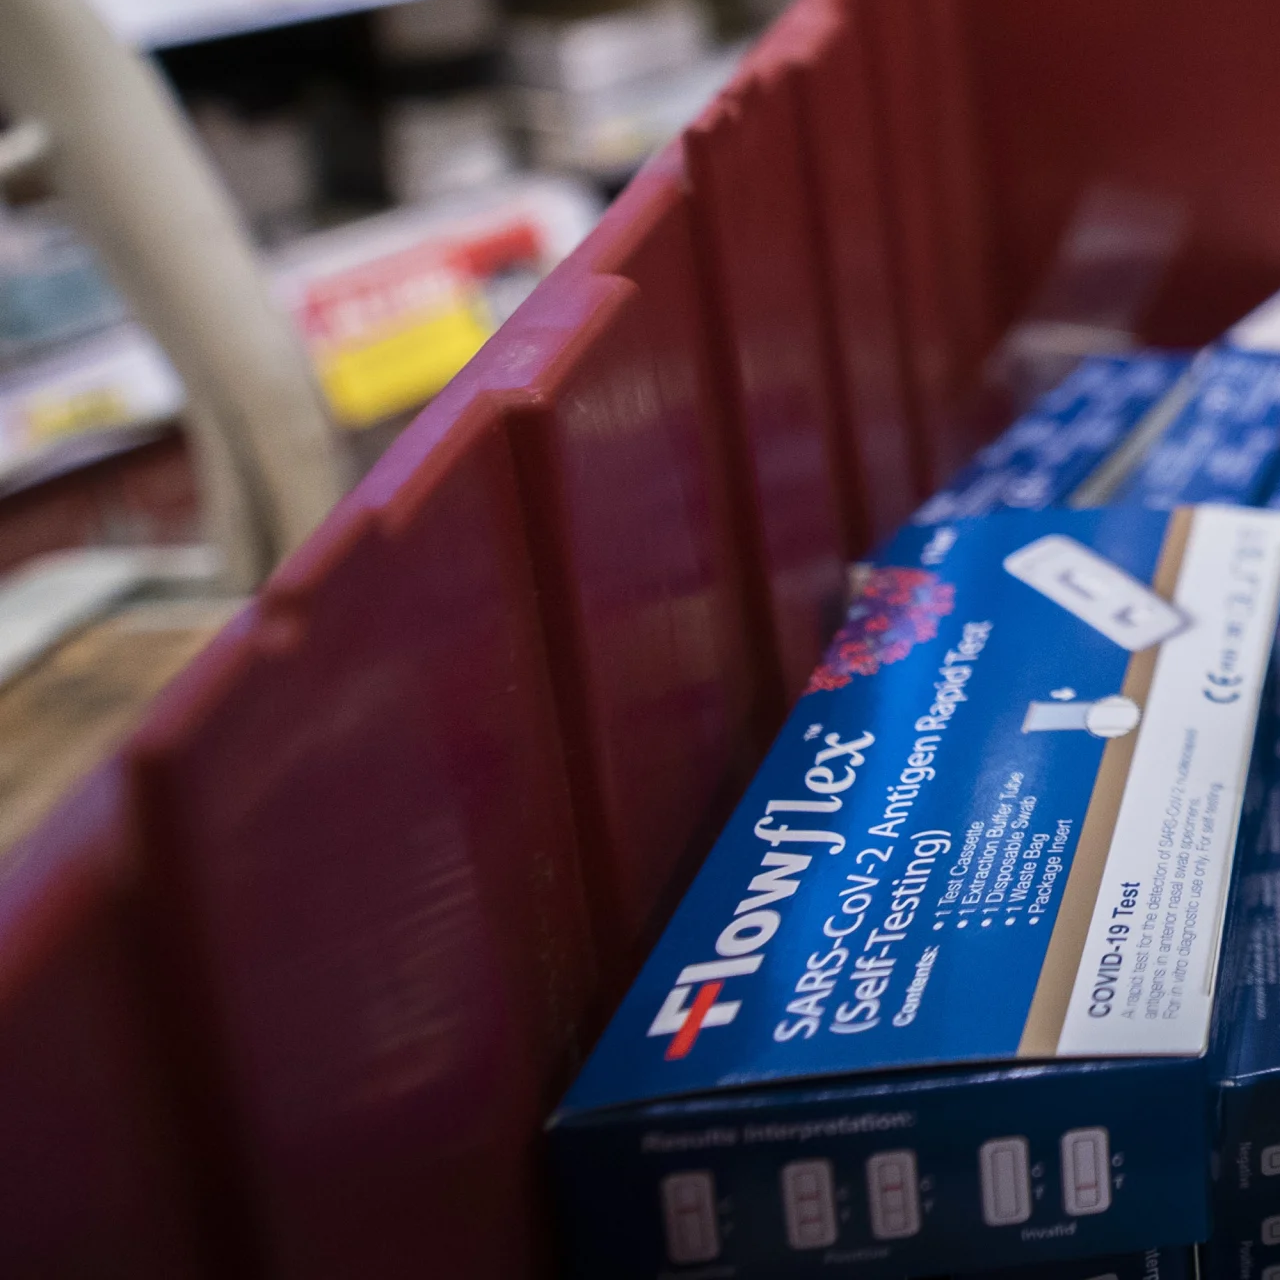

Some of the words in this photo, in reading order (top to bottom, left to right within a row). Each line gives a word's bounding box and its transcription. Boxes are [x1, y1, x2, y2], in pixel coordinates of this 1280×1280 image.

[774, 846, 894, 1042] SARS-CoV-2
[868, 735, 941, 838] Antigen
[914, 664, 972, 732] Rapid
[944, 621, 992, 662] Test
[949, 821, 985, 876] Cassette
[961, 840, 1000, 904] Extraction
[985, 803, 1012, 838] Buffer
[999, 772, 1024, 800] Tube
[1022, 833, 1050, 859] Bag
[1195, 835, 1211, 851] For
[985, 831, 1025, 903] Disposable
[1010, 796, 1037, 829] Swab
[1028, 856, 1063, 914] Package
[1047, 819, 1073, 853] Insert
[1174, 852, 1190, 879] swab
[1194, 855, 1210, 877] only.
[648, 730, 875, 1060] Flowflex
[937, 879, 964, 906] Test
[1008, 862, 1037, 902] Waste
[1146, 862, 1167, 910] detection
[1168, 881, 1183, 909] nasal
[1191, 879, 1204, 898] use
[830, 830, 951, 1034] (Self-Testing)
[1142, 913, 1158, 930] the
[1159, 912, 1177, 953] anterior
[1176, 901, 1199, 956] diagnostic
[1088, 924, 1130, 1018] COVID-19
[1112, 882, 1140, 918] Test
[1136, 933, 1152, 949] for
[1133, 951, 1149, 973] test
[1172, 959, 1189, 983] vitro
[892, 946, 939, 1027] Contents:
[1126, 976, 1144, 1007] rapid
[1144, 969, 1166, 1020] antigens
[1121, 1009, 1135, 1019] A
[1162, 999, 1181, 1019] For
[1237, 1141, 1252, 1190] Negative
[1021, 1222, 1077, 1242] Invalid
